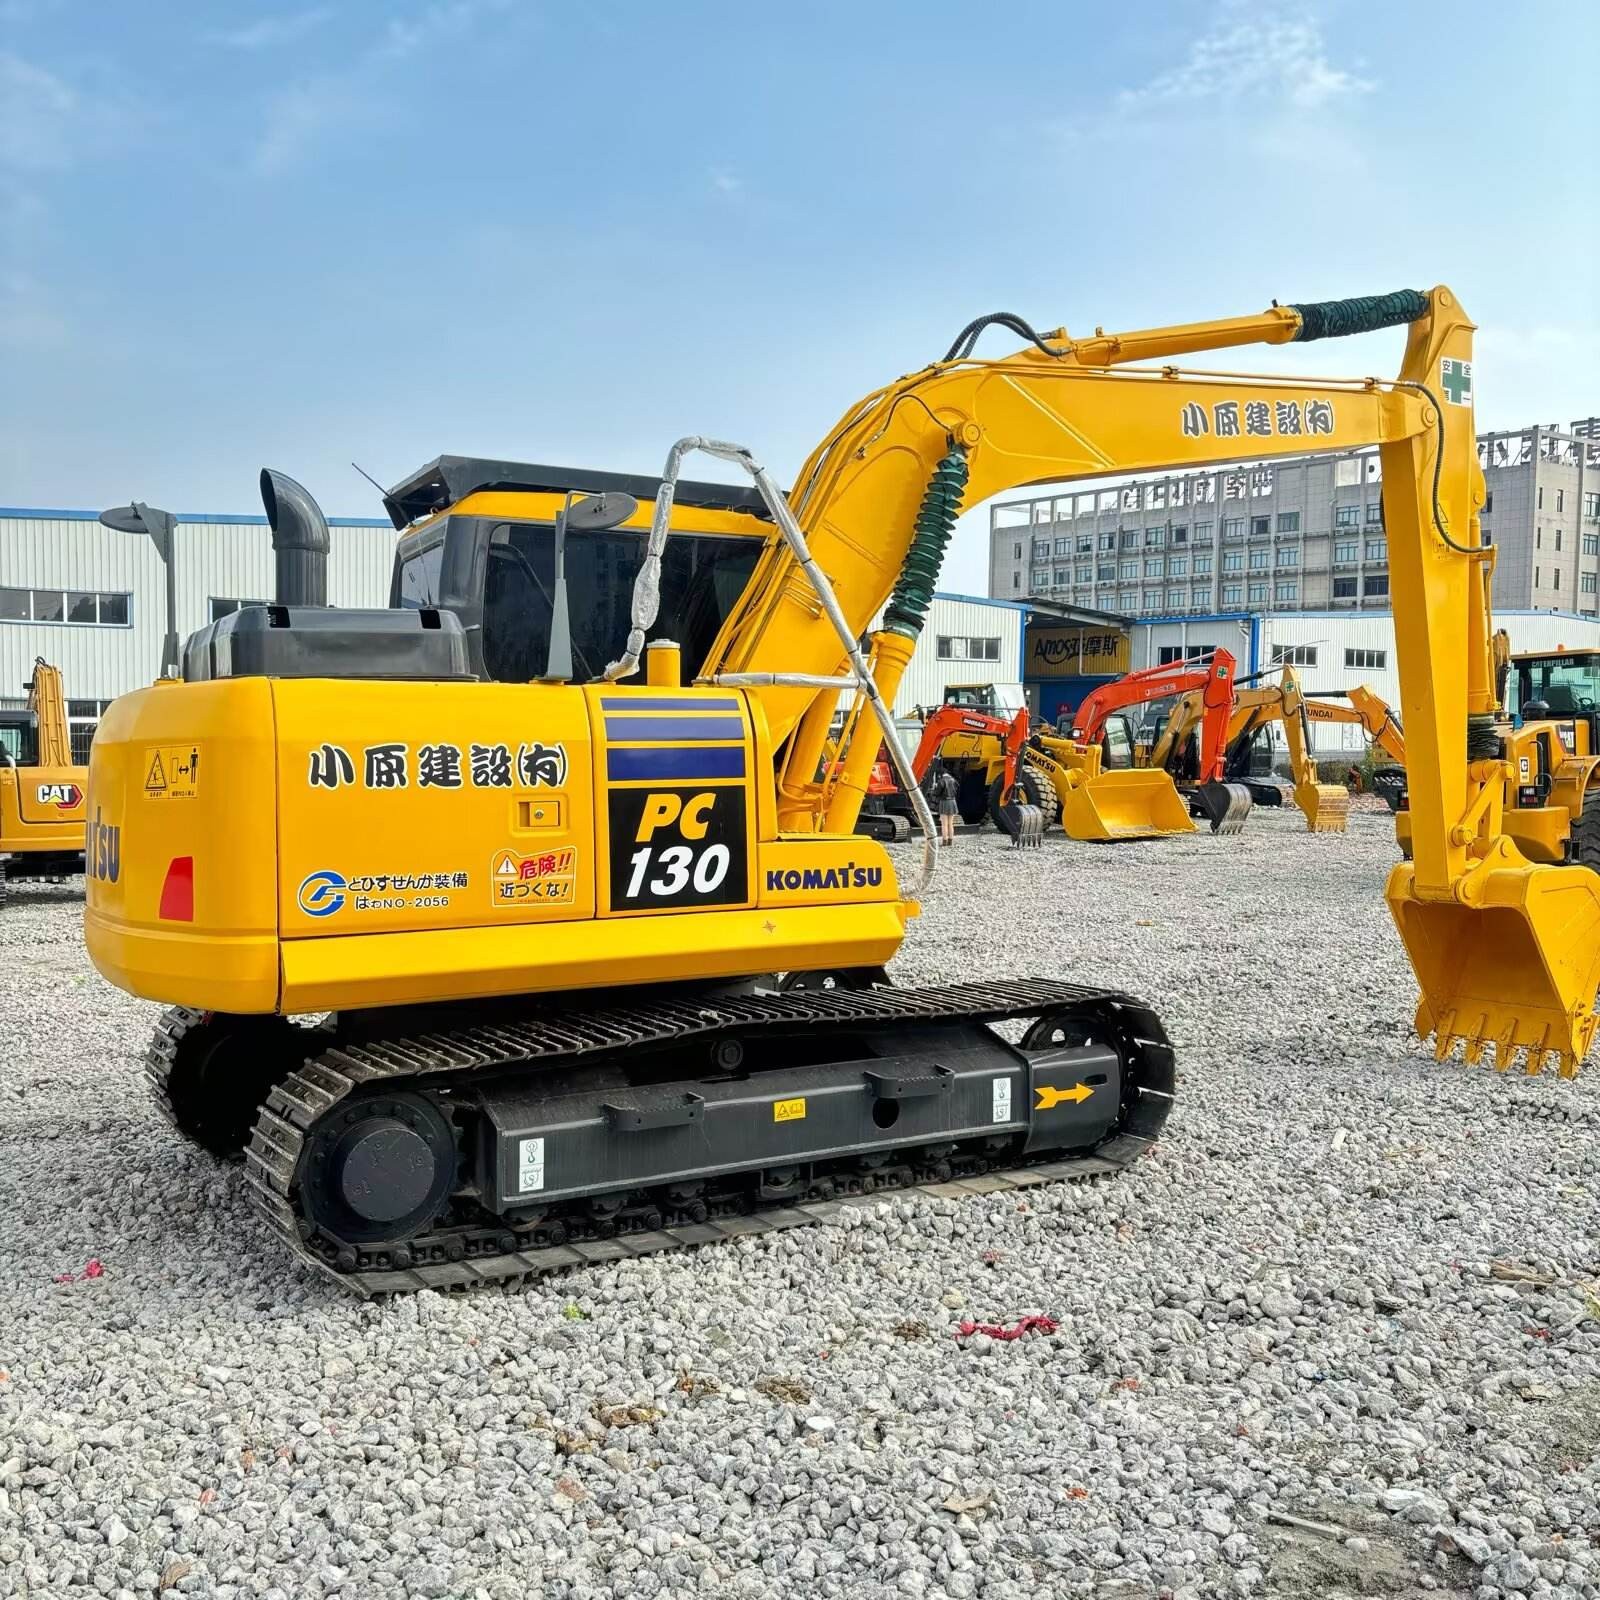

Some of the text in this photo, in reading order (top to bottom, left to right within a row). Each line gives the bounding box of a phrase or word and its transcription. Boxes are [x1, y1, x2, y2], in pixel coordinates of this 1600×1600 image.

[1307, 710, 1333, 718] UNDAI
[1025, 751, 1056, 773] OMATSU
[37, 784, 73, 803] CAT
[635, 792, 716, 842] PC
[626, 844, 730, 898] 130
[767, 862, 882, 891] KOMATSU
